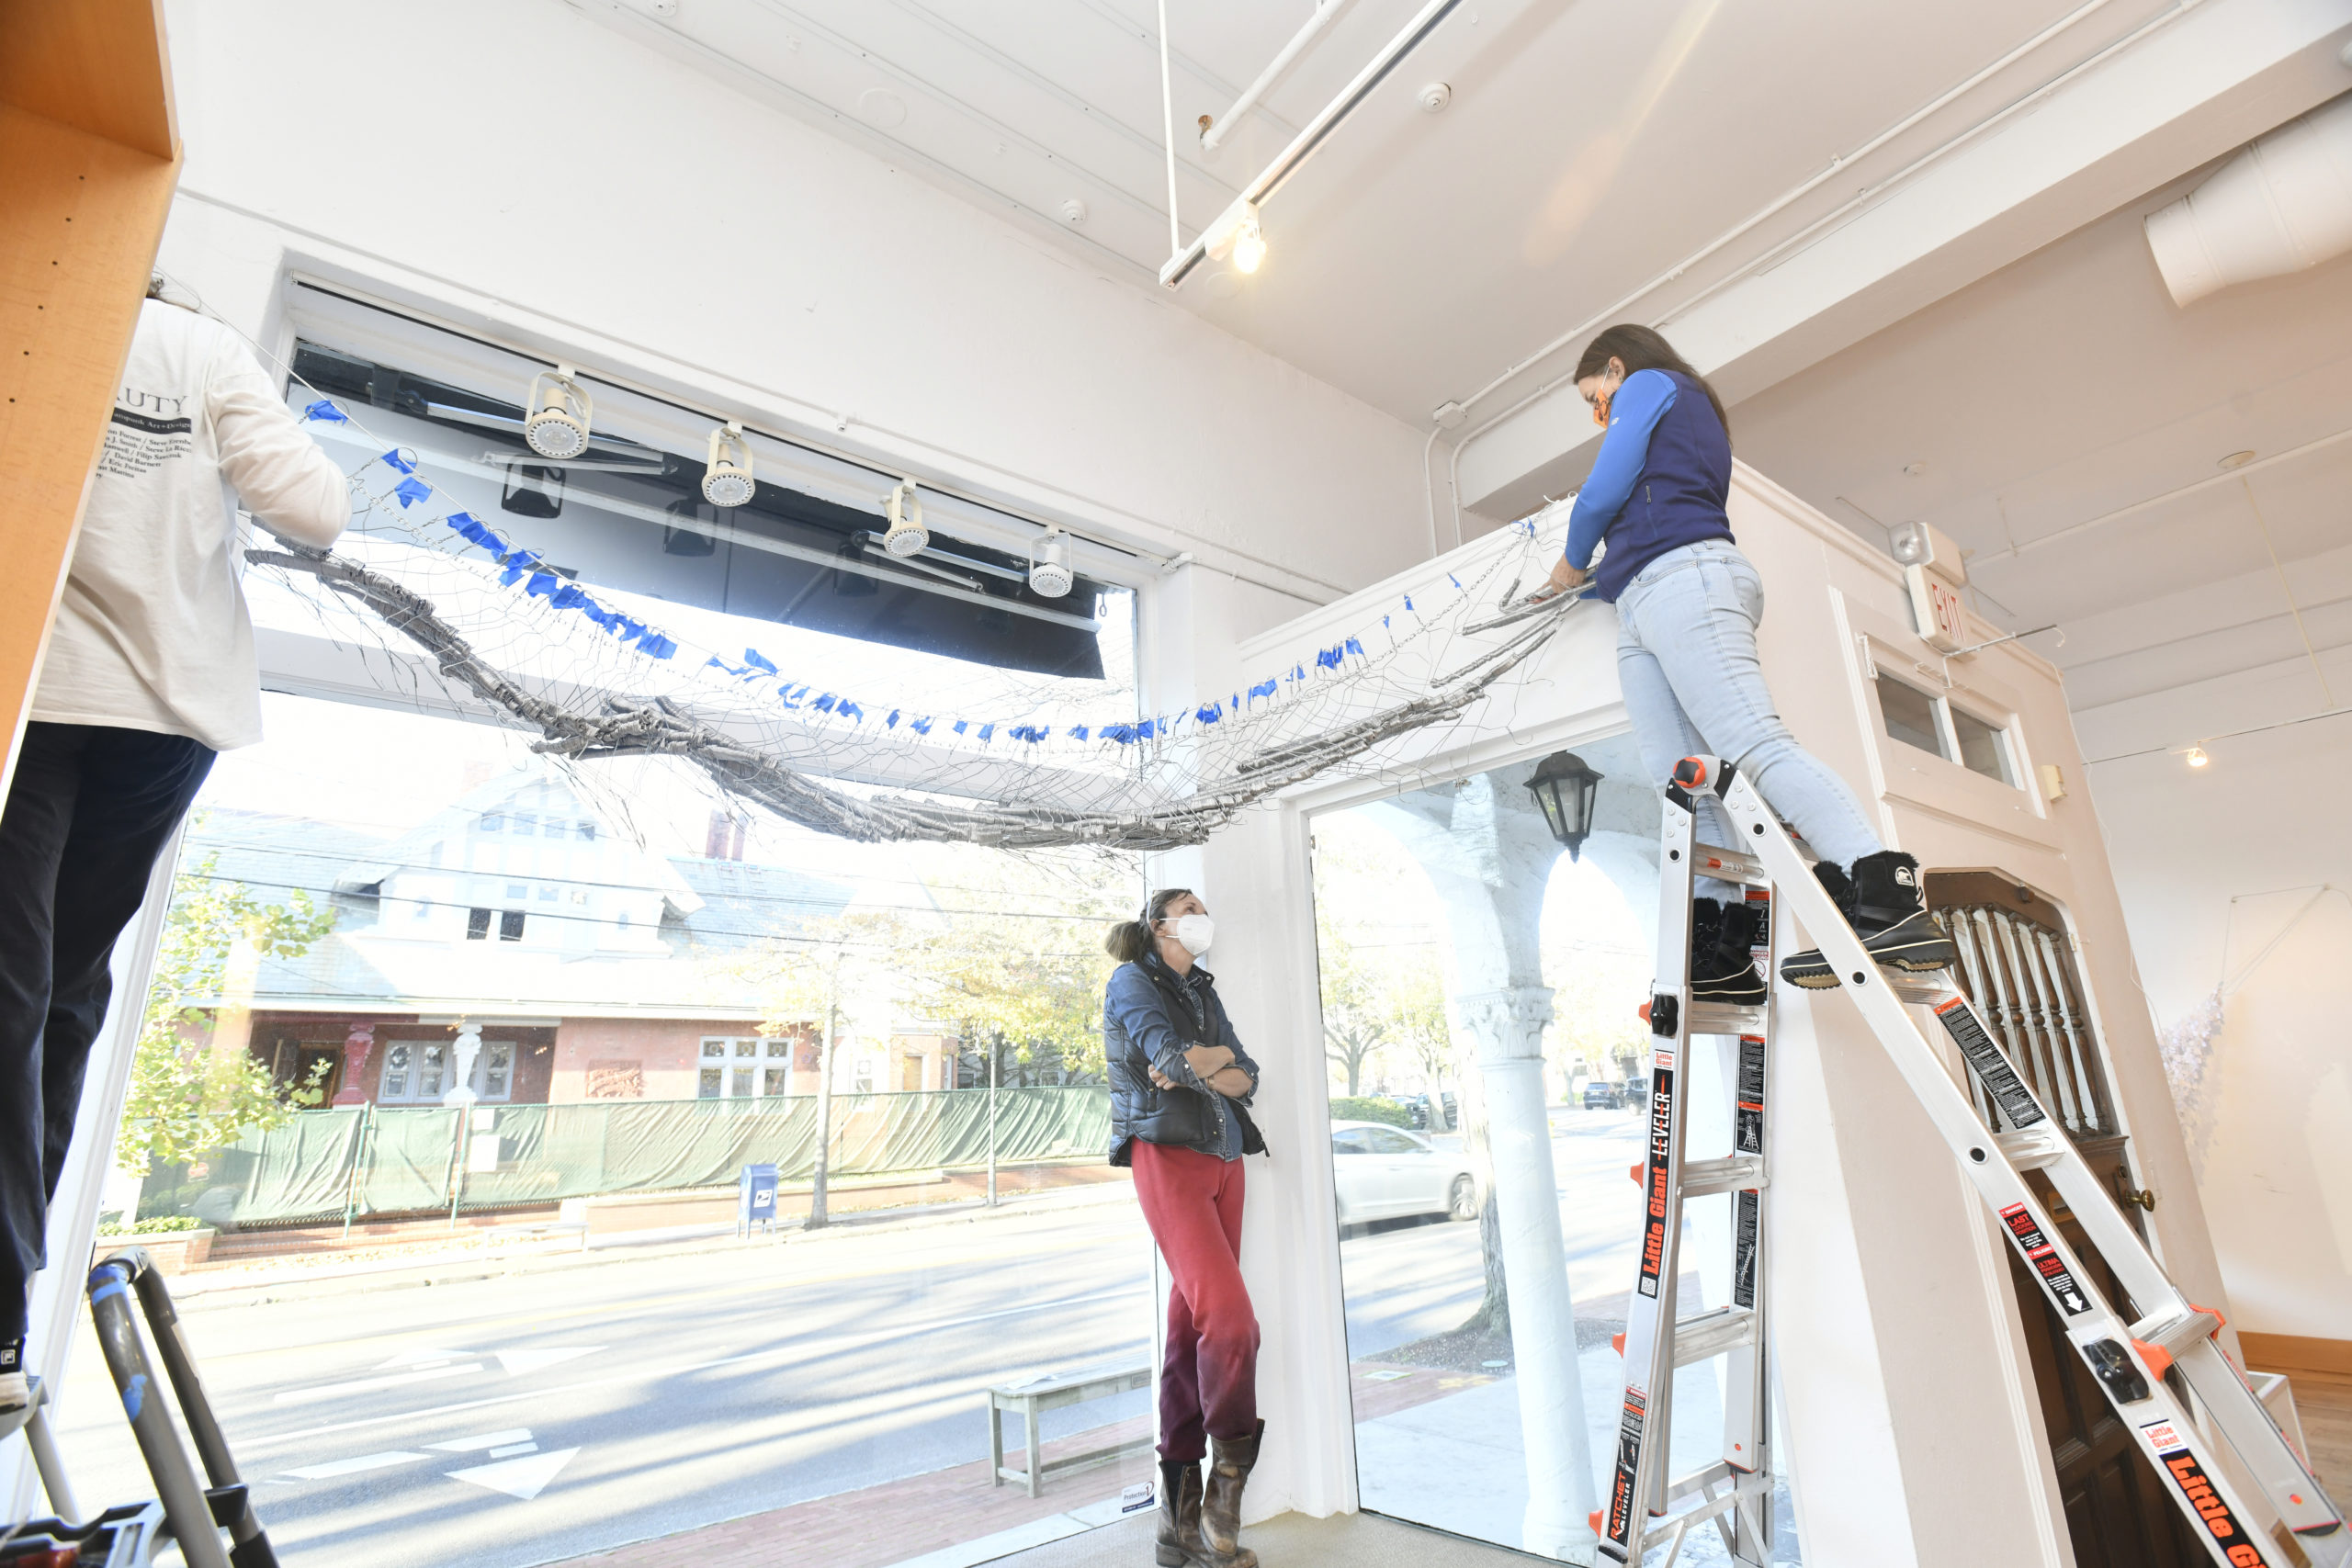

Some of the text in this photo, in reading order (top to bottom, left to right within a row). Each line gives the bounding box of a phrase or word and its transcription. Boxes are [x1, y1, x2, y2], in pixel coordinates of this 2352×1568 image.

[117, 387, 188, 415] UTY
[120, 440, 138, 449] Smith
[115, 452, 133, 462] David
[135, 459, 161, 467] Barnett
[137, 451, 152, 460] Filip
[109, 459, 122, 467] Eric
[1656, 1052, 1672, 1060] Little
[1643, 1092, 1670, 1275] Little Giant LEVELER
[2007, 1213, 2030, 1227] LAST
[2145, 1426, 2174, 1439] Little
[2152, 1435, 2180, 1448] Giant
[1621, 1483, 1631, 1521] LEVELER
[2166, 1456, 2233, 1538] Little
[1611, 1471, 1626, 1539] RATCHET
